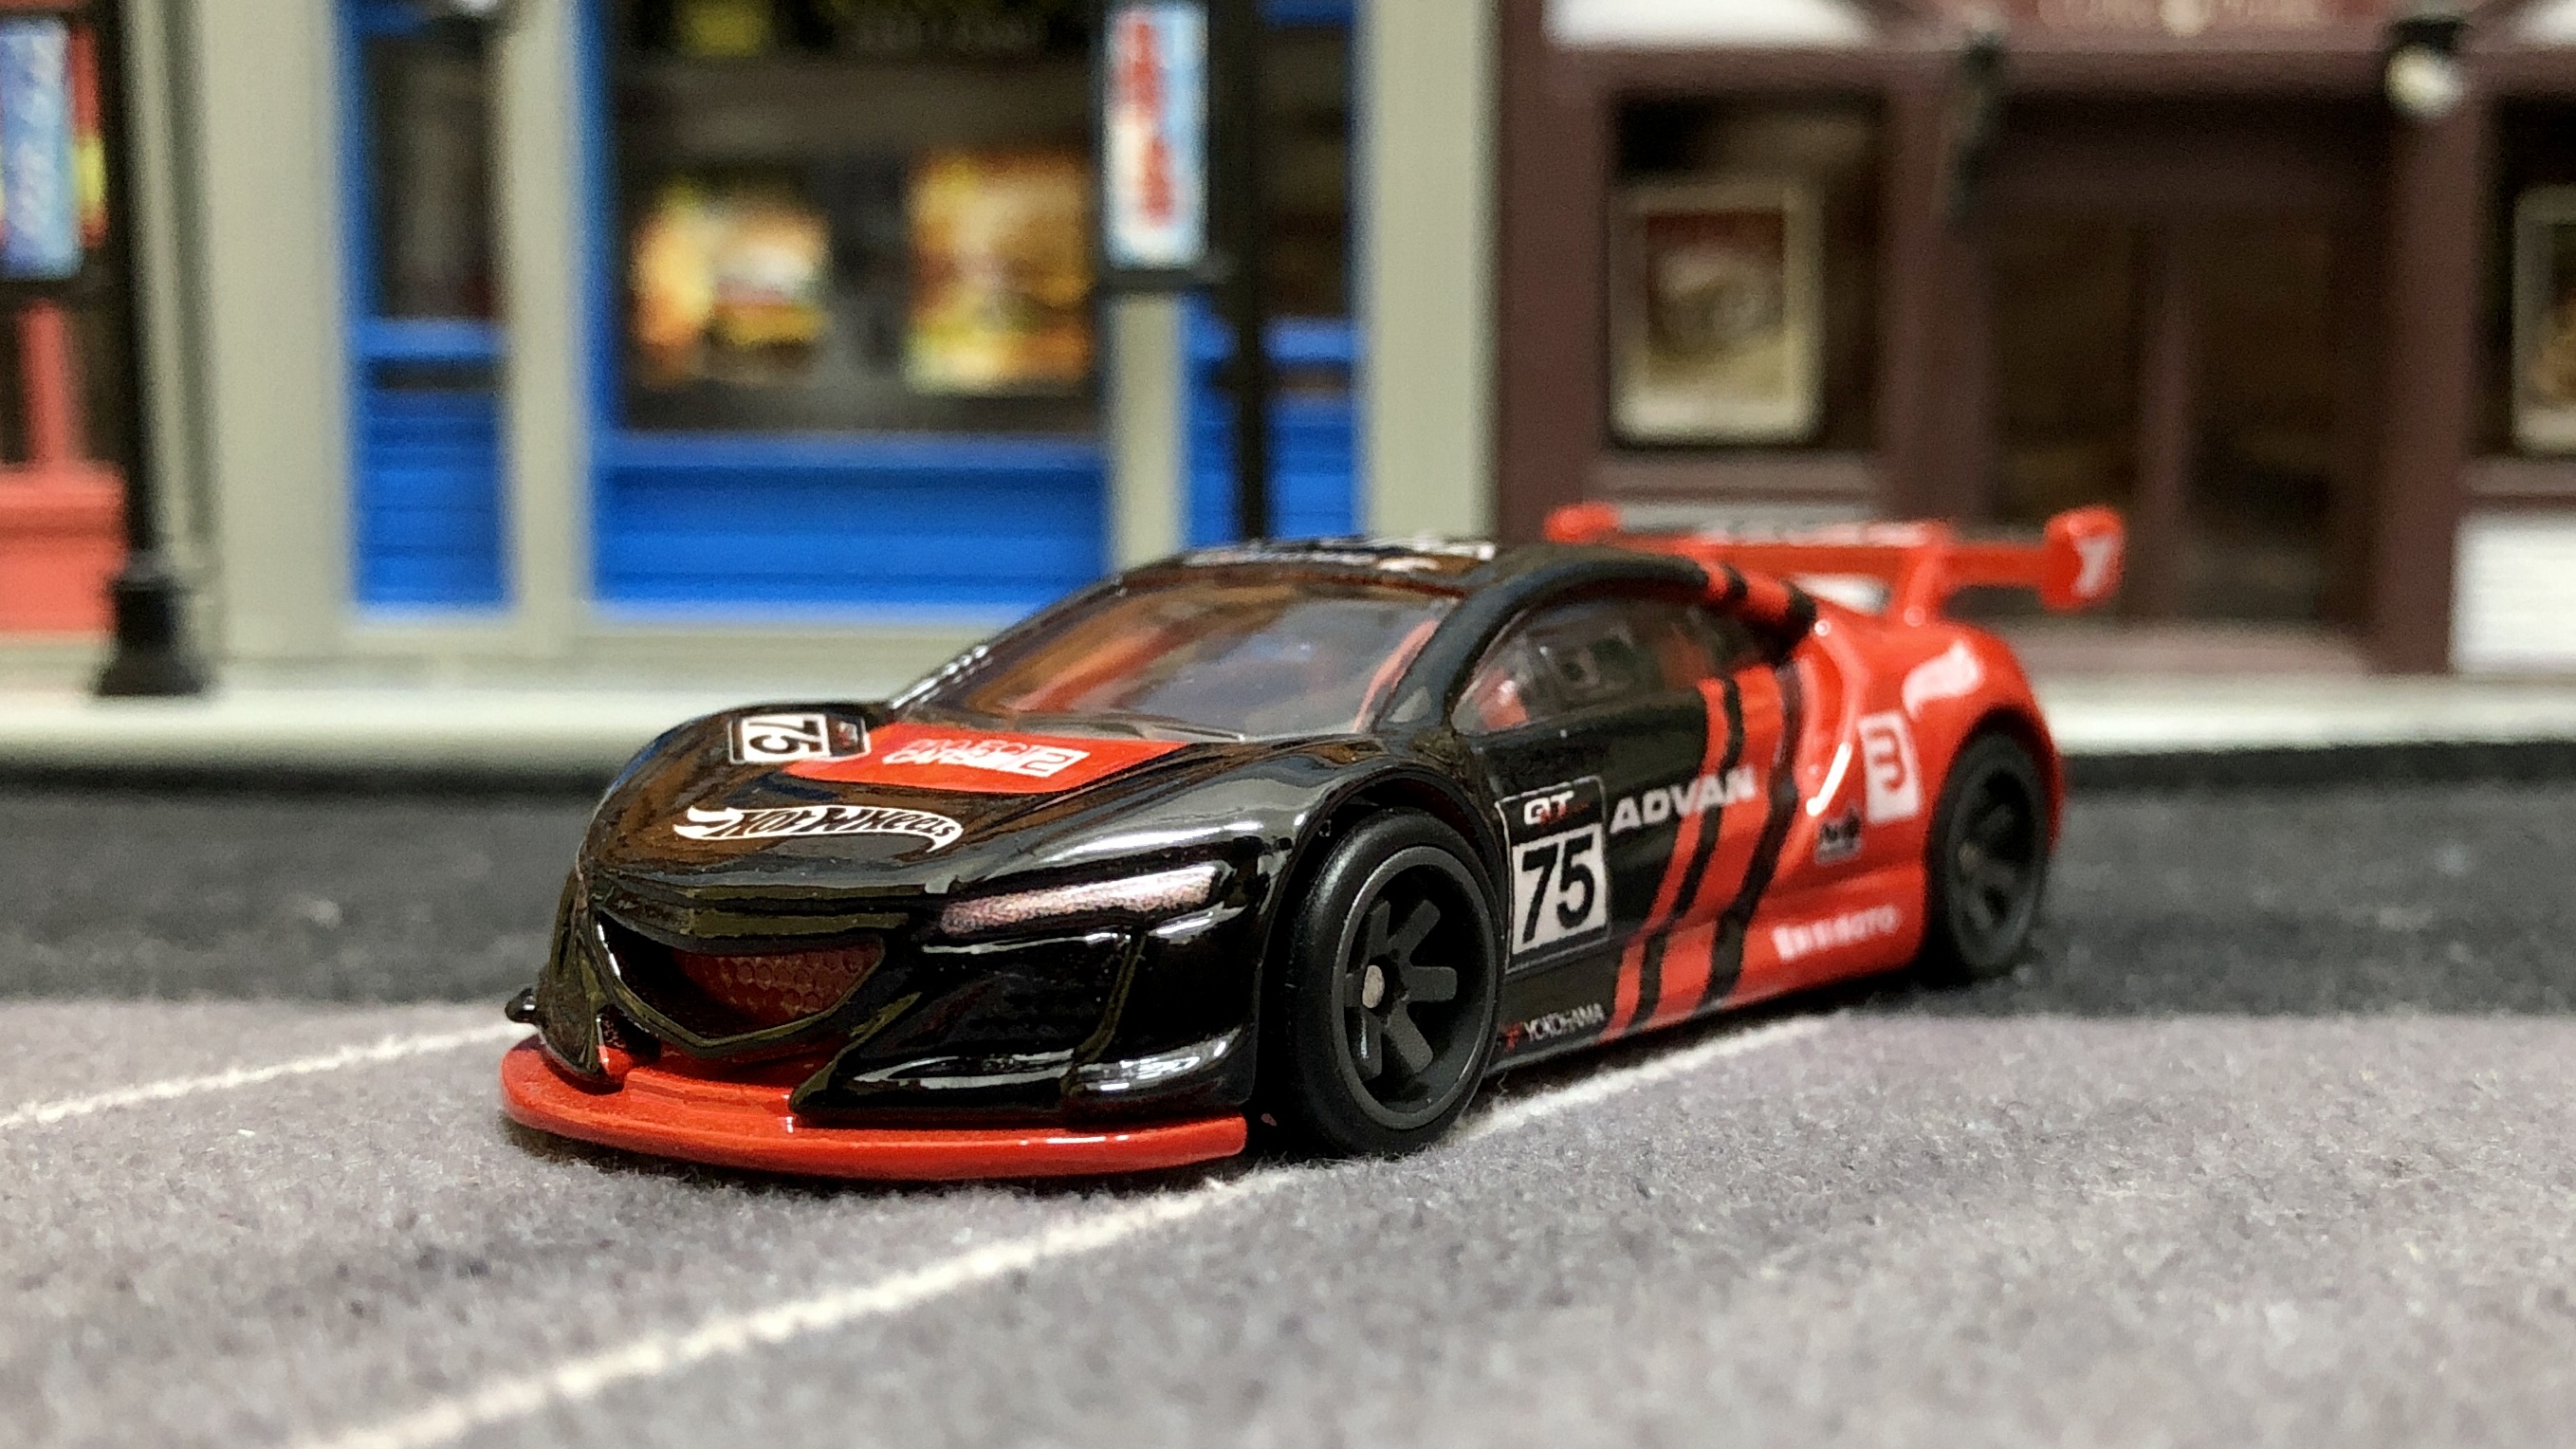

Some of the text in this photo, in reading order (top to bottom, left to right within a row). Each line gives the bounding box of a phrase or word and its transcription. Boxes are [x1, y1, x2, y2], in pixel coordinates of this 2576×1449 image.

[748, 719, 823, 755] 75
[1523, 790, 1574, 827] GT
[1610, 763, 1757, 835] ADVAN
[1521, 832, 1595, 945] 75
[1522, 1002, 1605, 1042] YOKOHAMA
